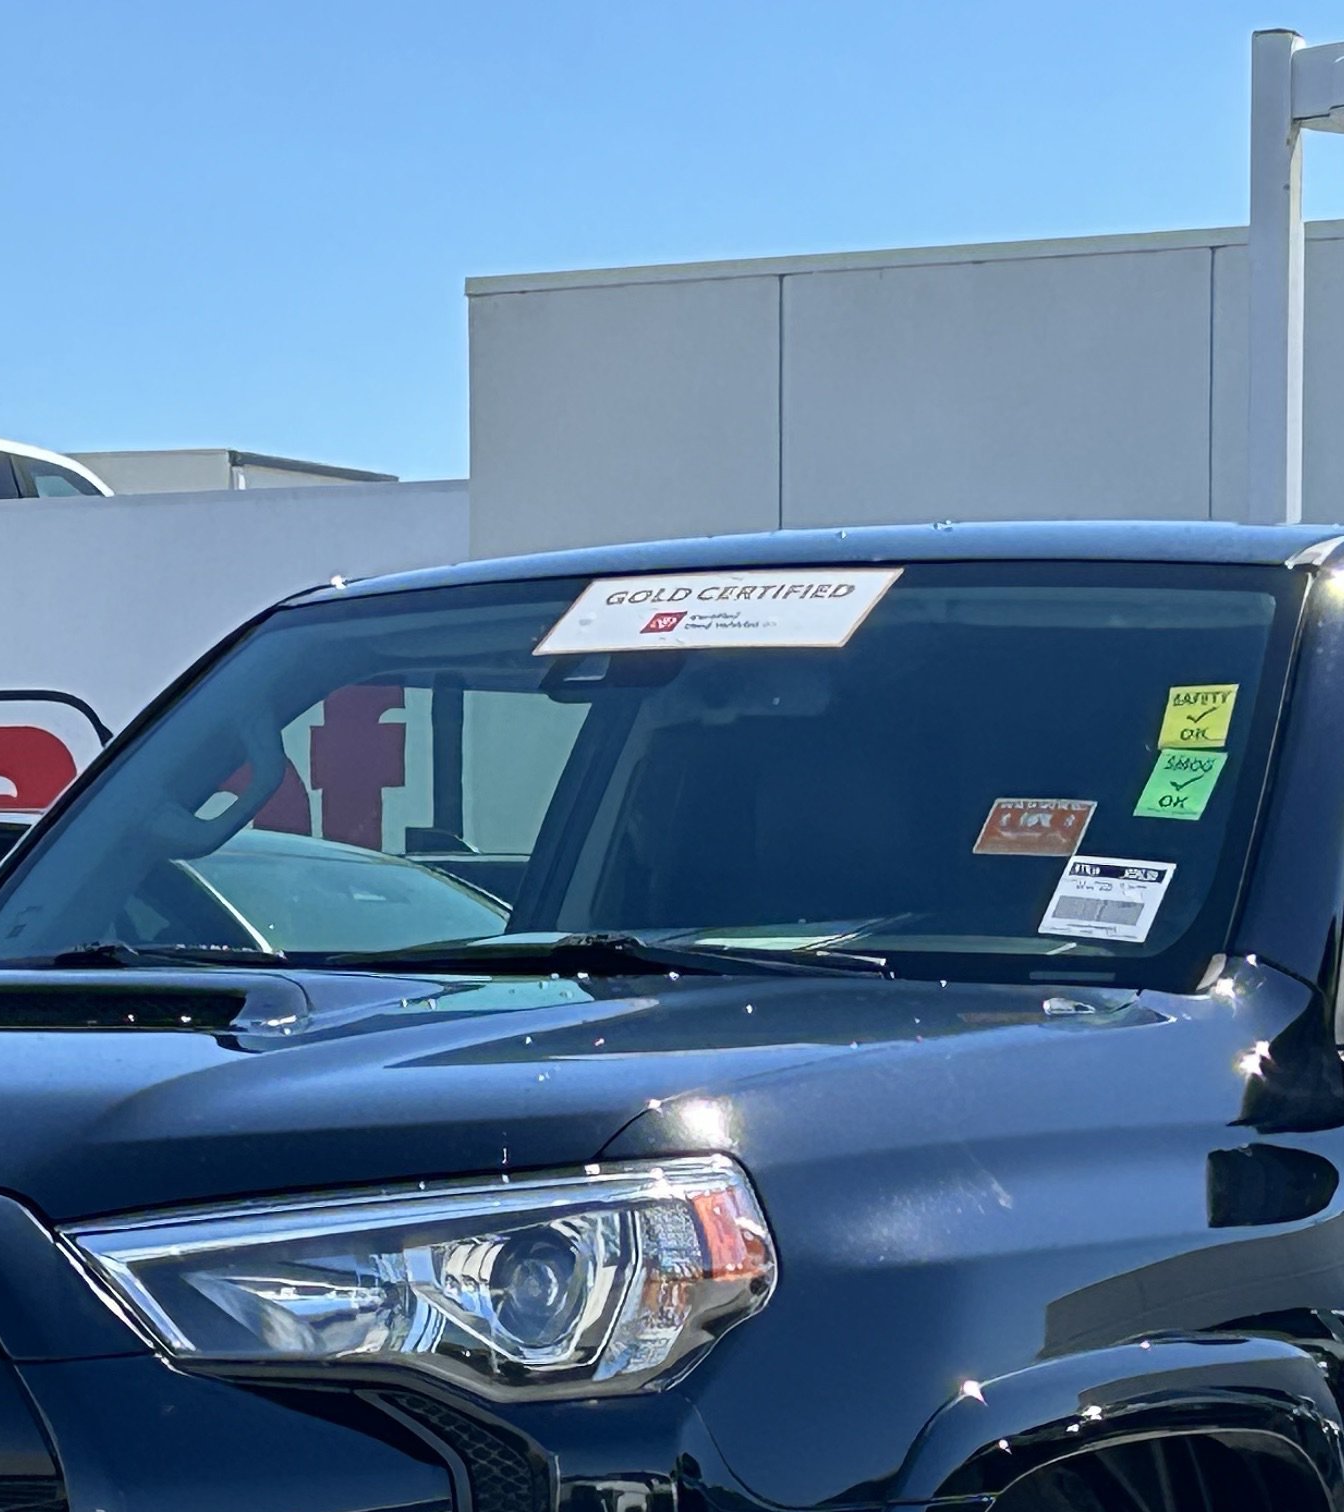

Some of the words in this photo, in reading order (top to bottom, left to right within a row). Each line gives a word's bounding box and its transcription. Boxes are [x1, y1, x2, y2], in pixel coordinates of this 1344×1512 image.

[605, 587, 693, 606] GOLD
[697, 583, 857, 601] CERTIFIED
[1158, 795, 1188, 809] OK
